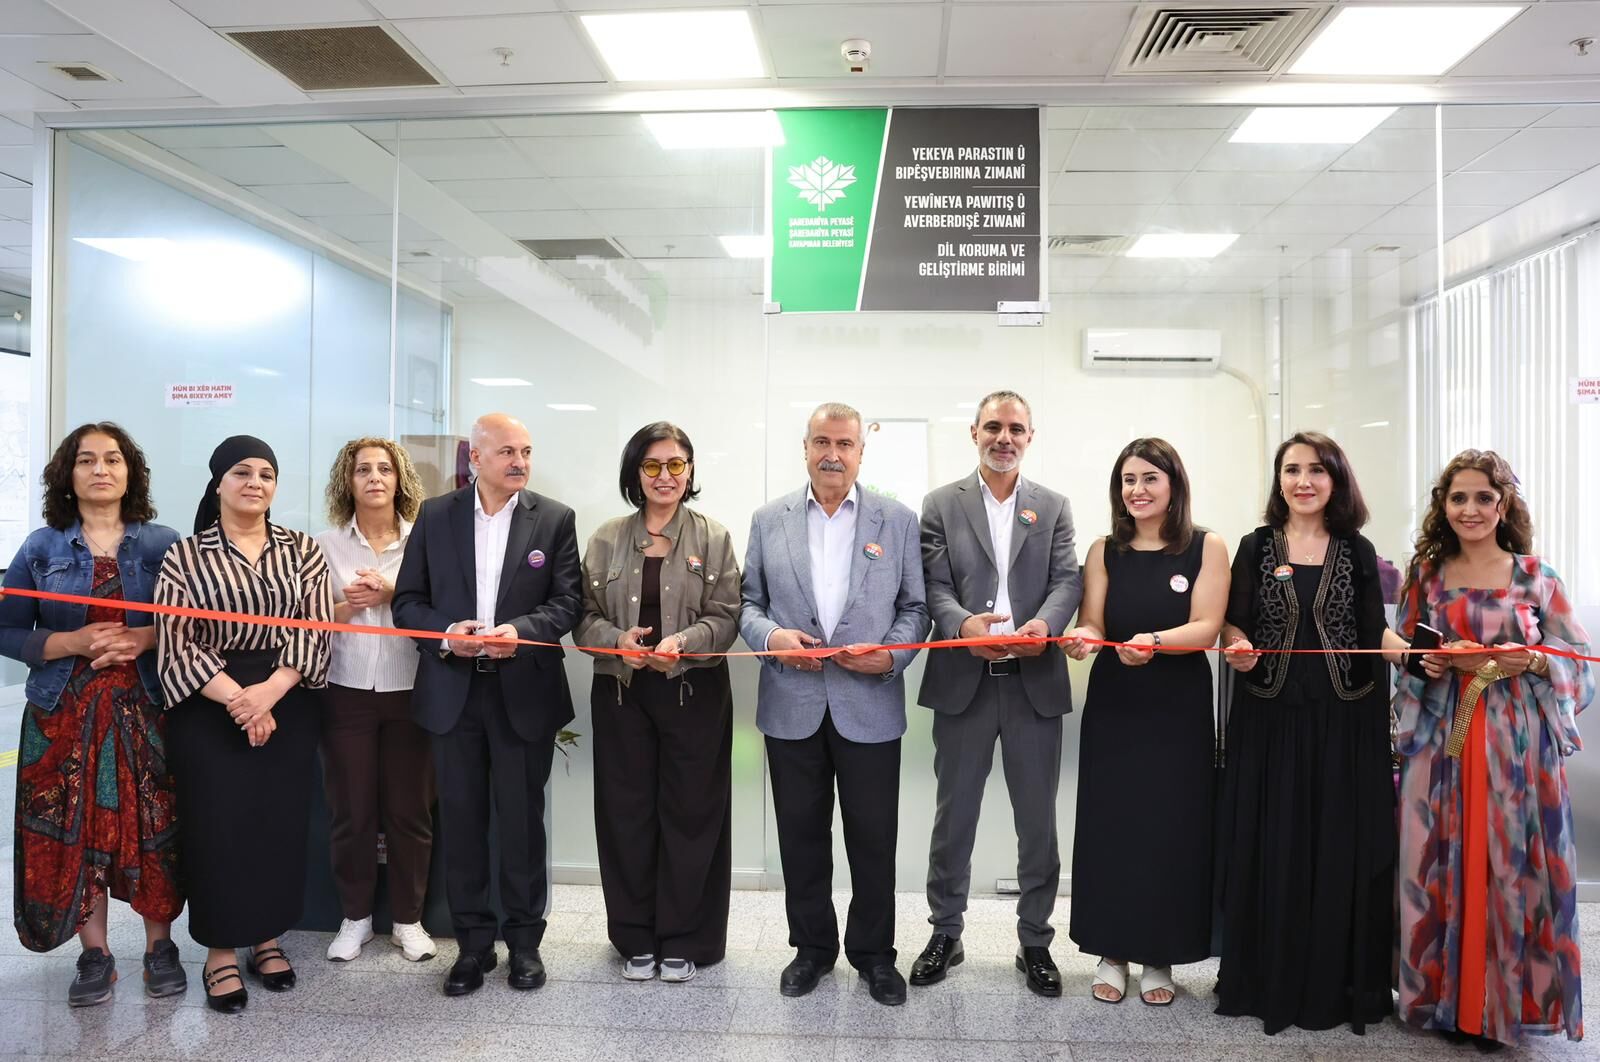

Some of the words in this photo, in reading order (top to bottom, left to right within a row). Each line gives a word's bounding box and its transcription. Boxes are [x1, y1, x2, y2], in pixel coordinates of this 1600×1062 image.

[912, 147, 955, 161] YEKEYA
[958, 147, 1014, 161] PARASTIN
[1017, 144, 1025, 161] Û
[895, 163, 981, 182] BIPÊŞVEBIRINA
[984, 163, 1026, 179] ZIMANÎ
[904, 192, 963, 209] YEWÎNEYA
[966, 195, 1014, 211] PAWITIŞ
[1017, 192, 1025, 209] Û
[903, 211, 980, 230] AVERBERDIŞÊ
[982, 211, 1026, 228] ZIWANÎ
[937, 241, 956, 257] DİL
[959, 243, 1008, 257] KORUMA
[1010, 243, 1026, 257] VE
[918, 260, 985, 279] GELİŞTİRME
[988, 260, 1025, 277] BİRİMİ
